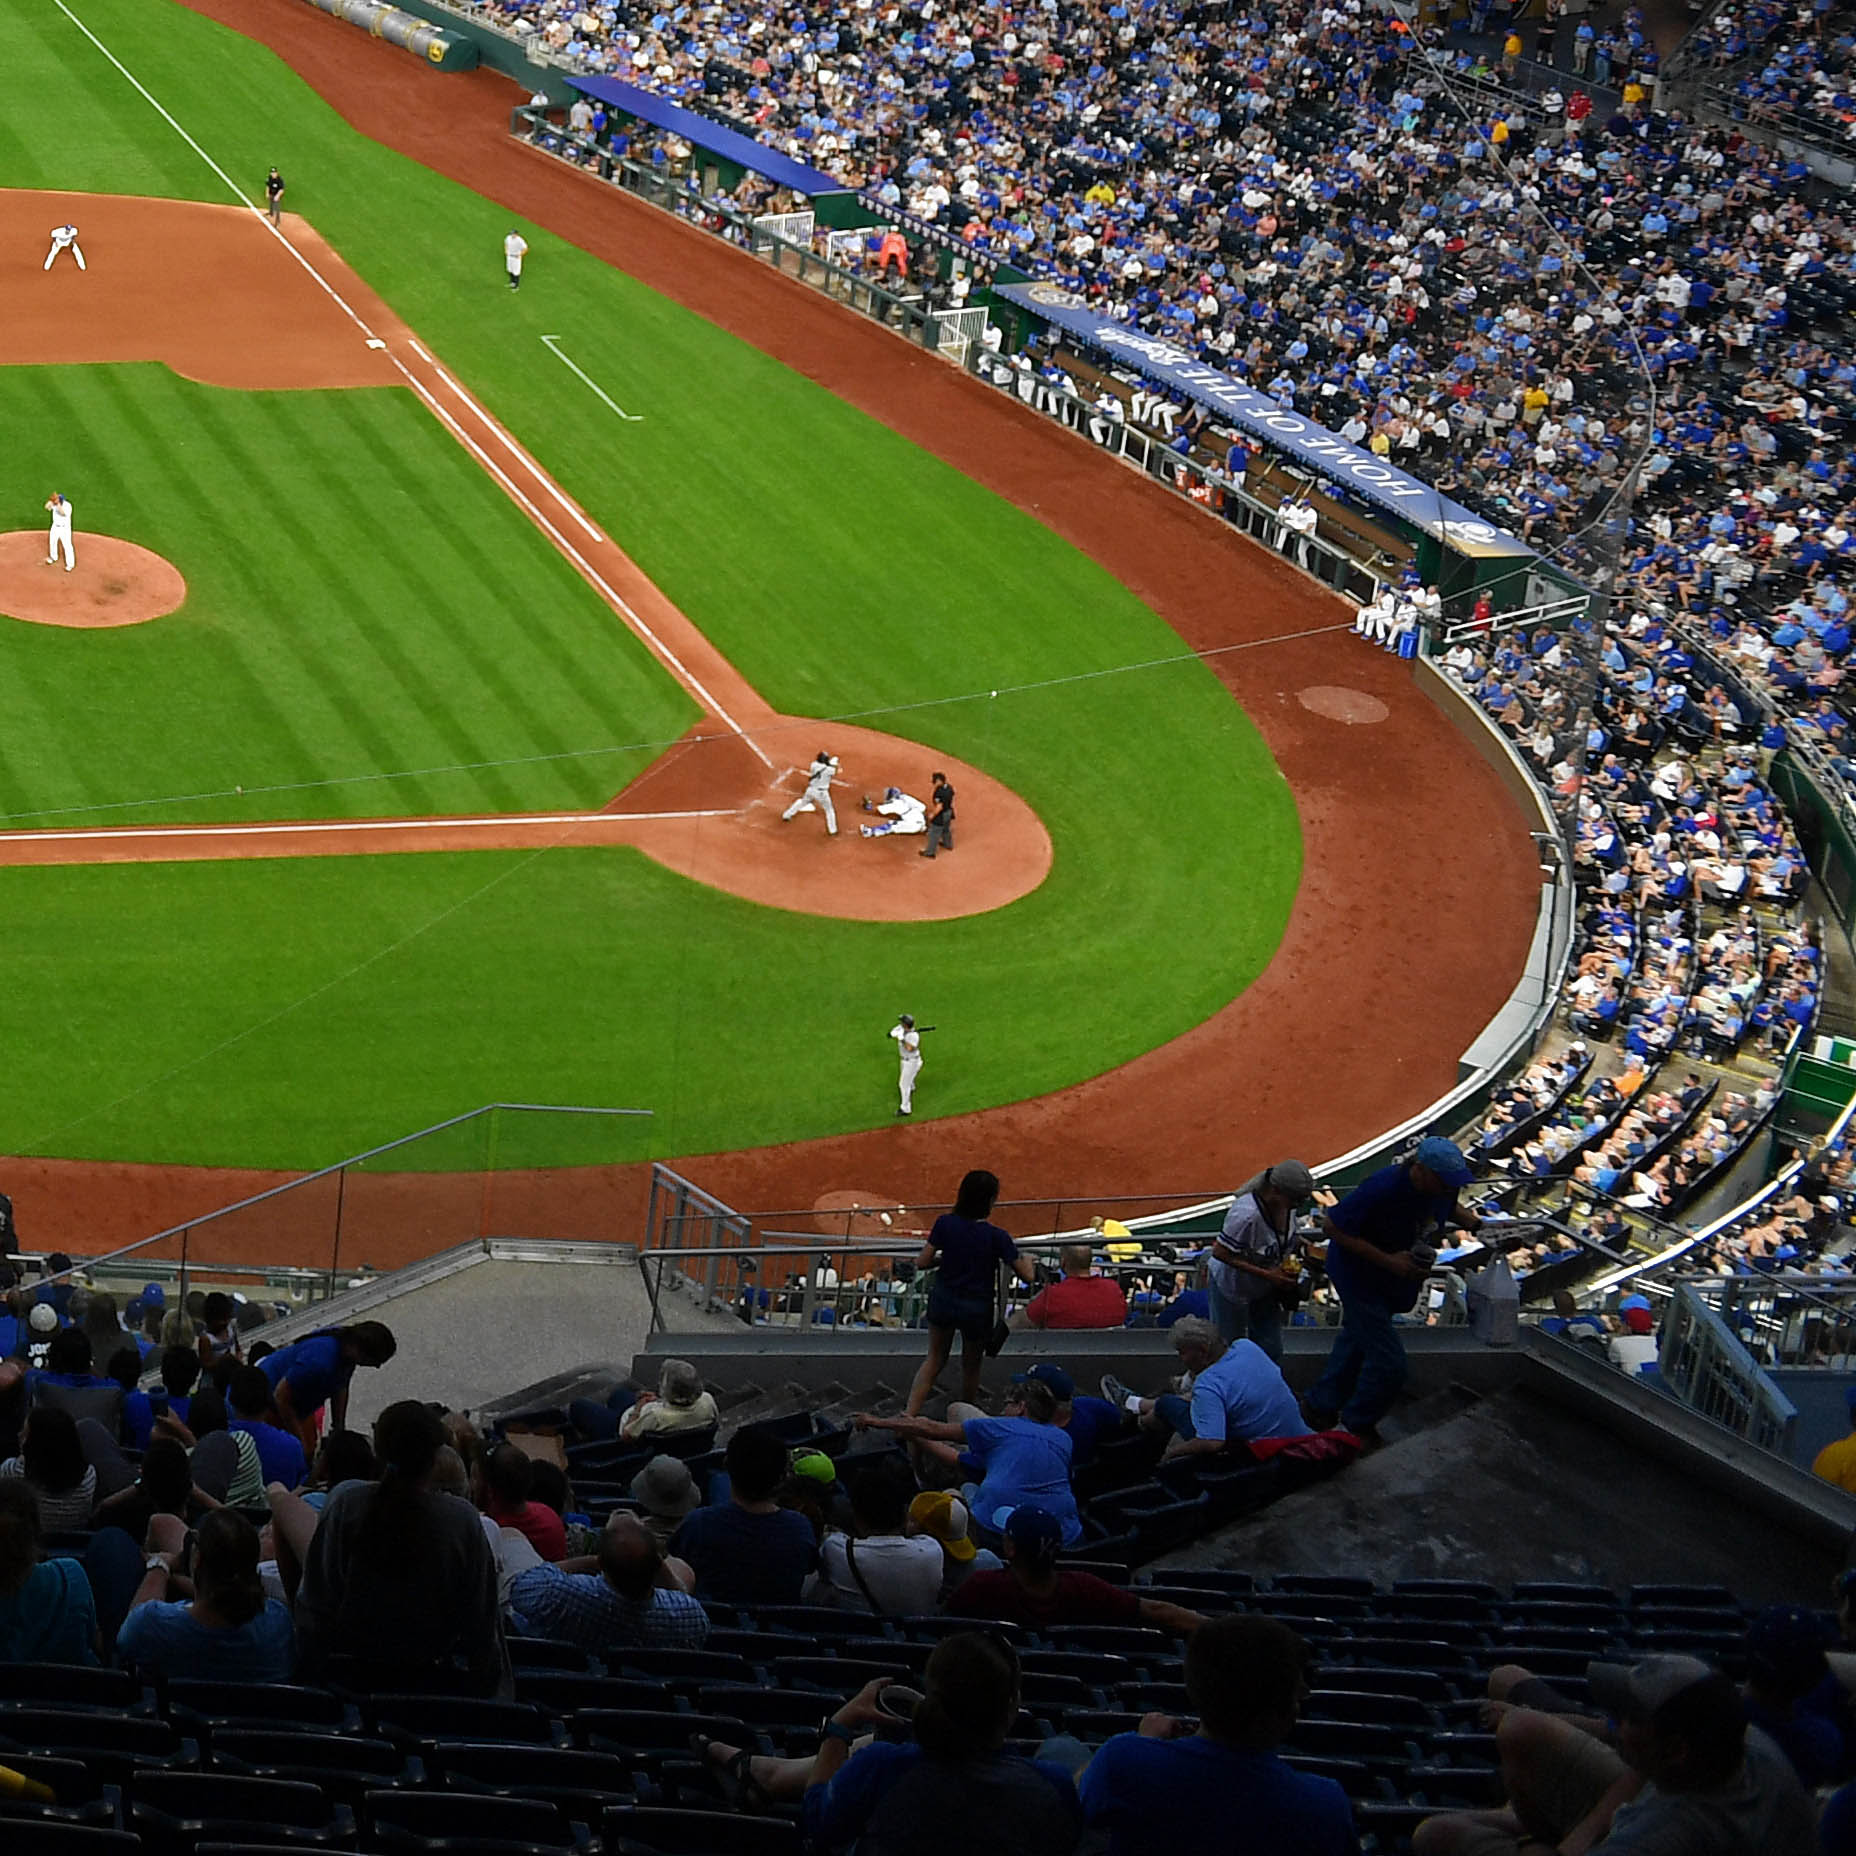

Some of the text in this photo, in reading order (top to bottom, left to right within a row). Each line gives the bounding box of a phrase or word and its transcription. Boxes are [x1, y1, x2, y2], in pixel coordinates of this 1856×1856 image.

[1175, 365, 1250, 408] THE
[1248, 404, 1307, 435] OF
[1297, 435, 1425, 498] HOME
